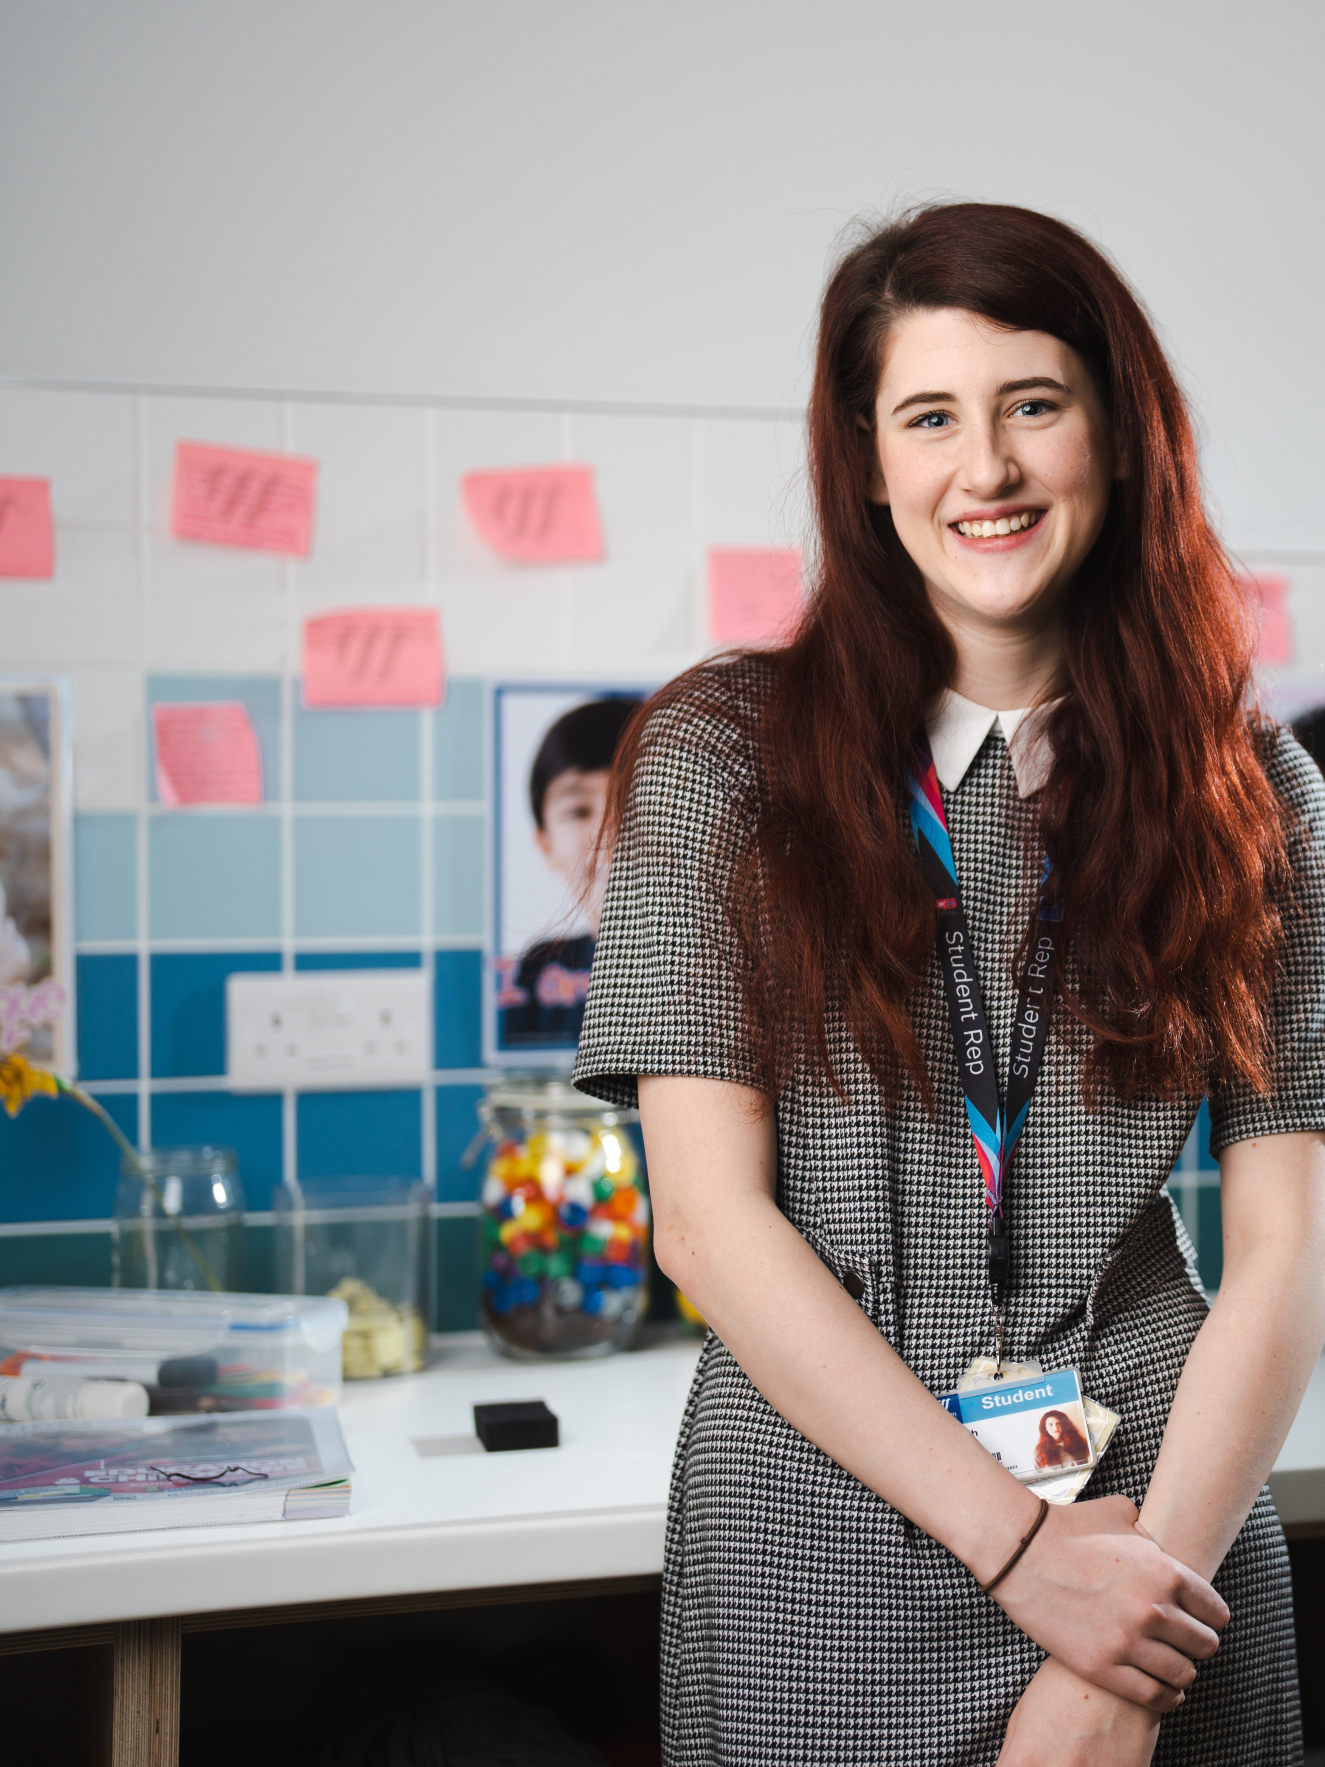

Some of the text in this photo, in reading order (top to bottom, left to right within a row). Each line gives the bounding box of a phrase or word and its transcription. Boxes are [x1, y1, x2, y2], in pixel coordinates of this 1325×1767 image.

[1027, 936, 1055, 978] Rep
[945, 931, 979, 1022] Student
[963, 1029, 984, 1075] Rep
[981, 1384, 1054, 1410] Student
